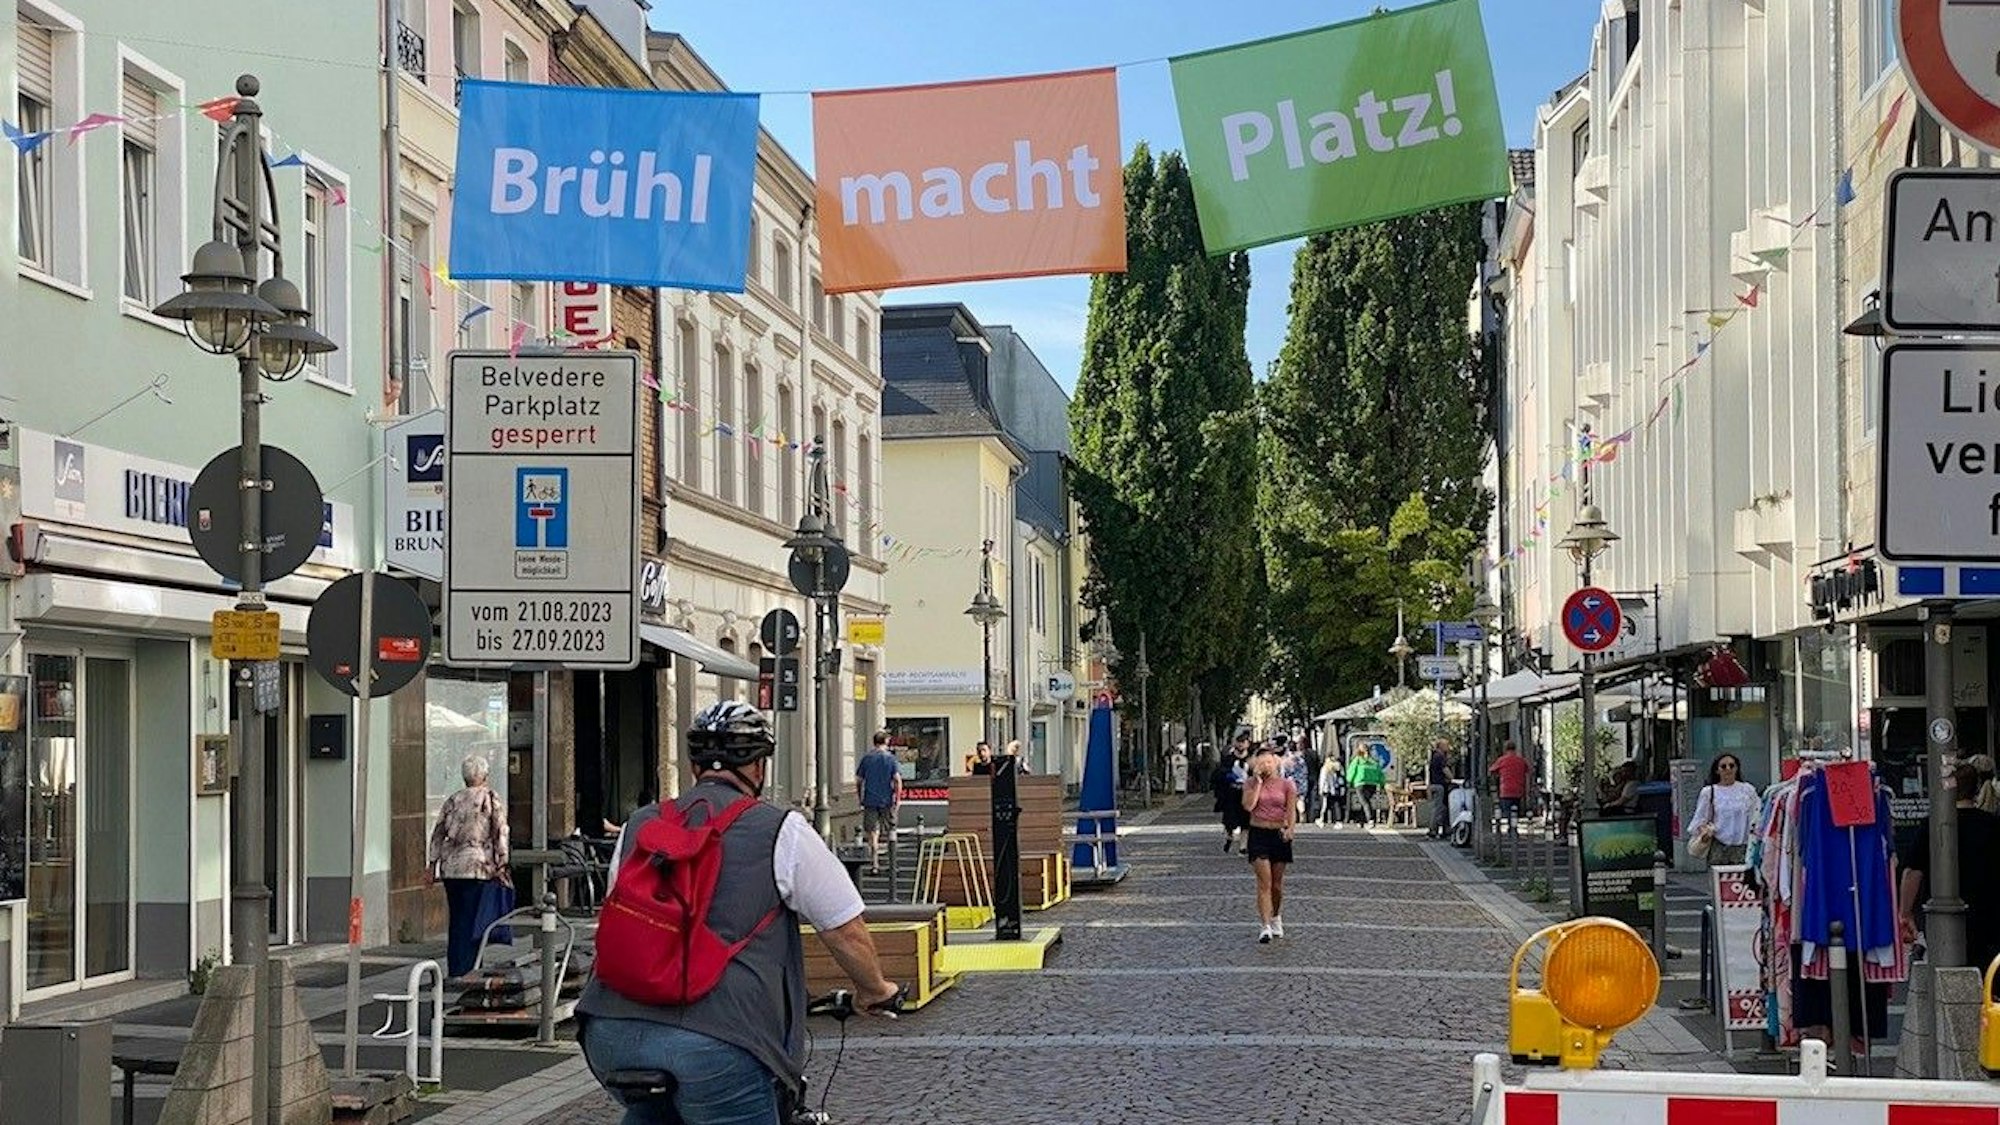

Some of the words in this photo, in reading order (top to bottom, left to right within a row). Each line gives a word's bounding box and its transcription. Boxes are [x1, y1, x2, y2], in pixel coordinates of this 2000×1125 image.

[490, 147, 712, 224] Brühl
[840, 139, 1101, 226] macht
[1221, 69, 1463, 182] Platz!
[482, 366, 605, 387] Belvedere
[485, 394, 601, 420] Parkplatz
[491, 424, 597, 449] gesperrt
[472, 605, 508, 621] vom
[518, 601, 612, 622] 21.08.2023
[477, 629, 502, 651] bis
[513, 629, 605, 651] 27.09.2023
